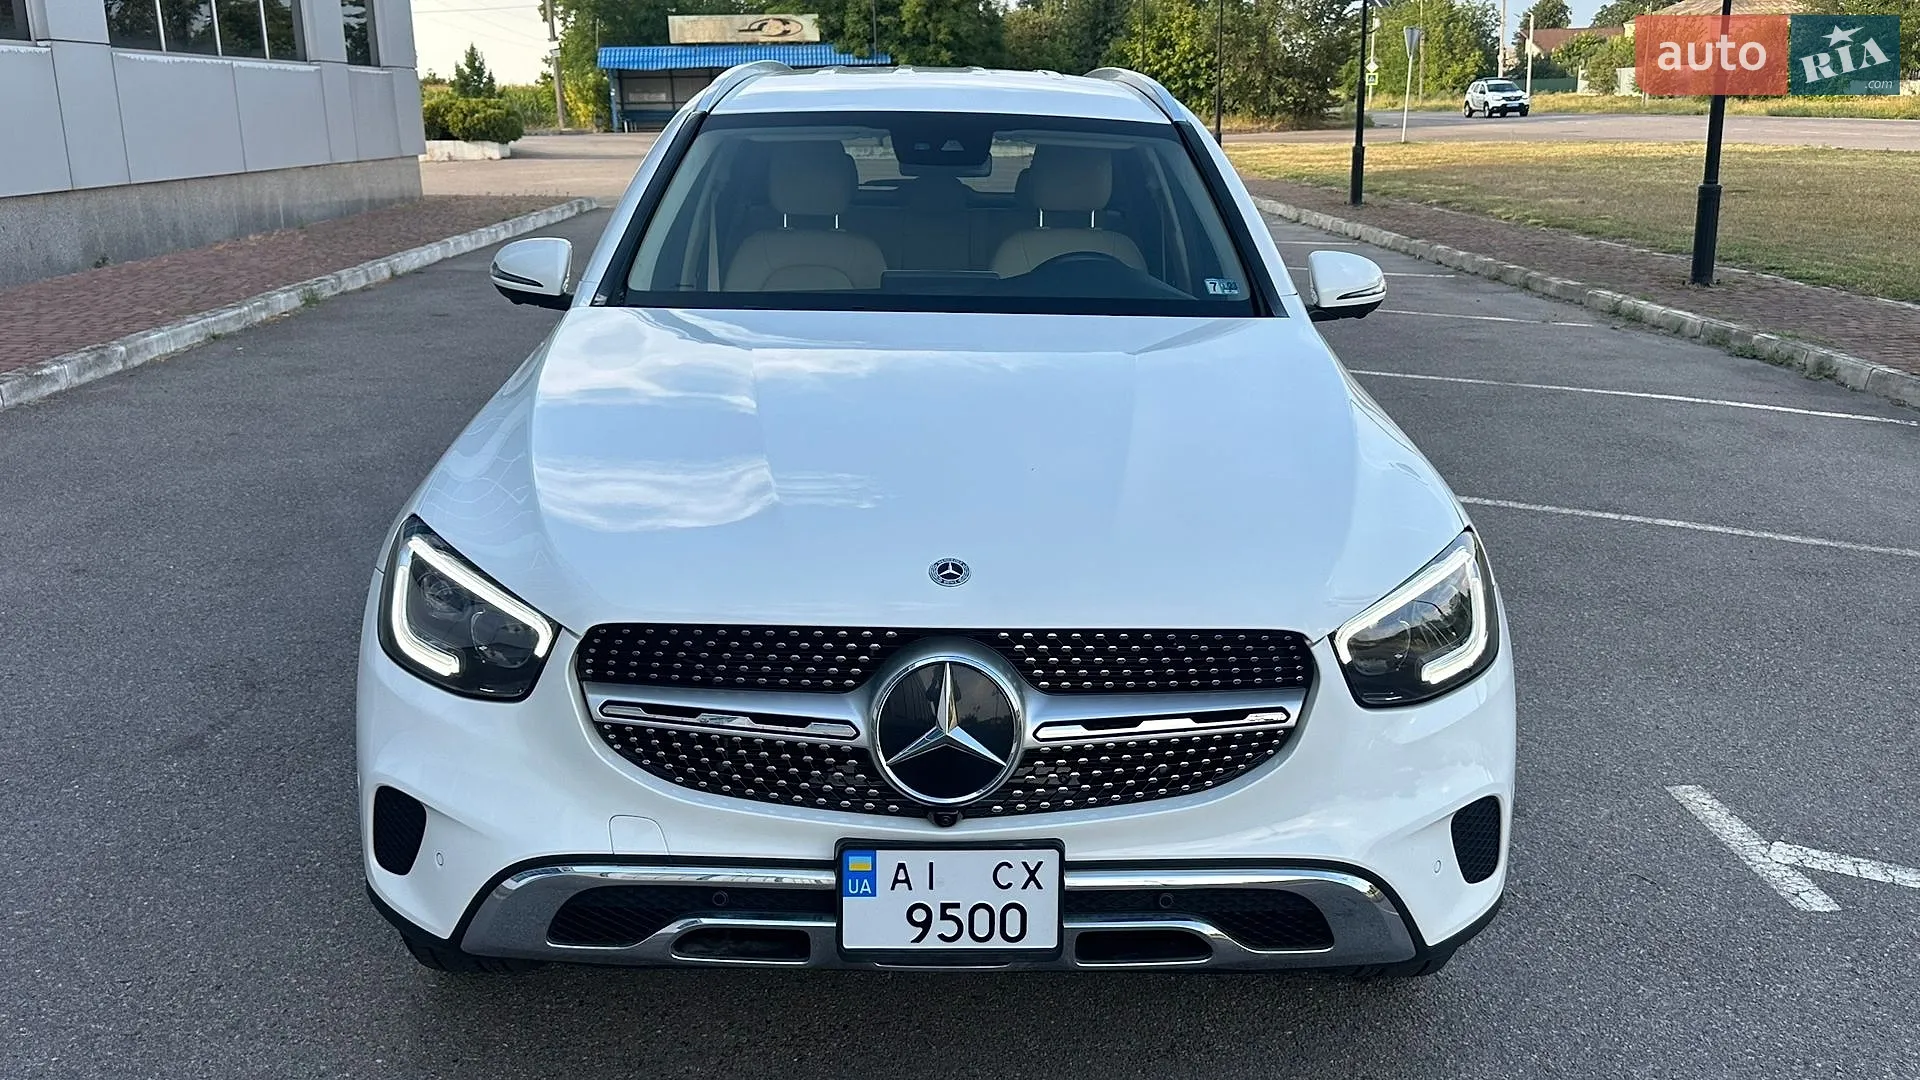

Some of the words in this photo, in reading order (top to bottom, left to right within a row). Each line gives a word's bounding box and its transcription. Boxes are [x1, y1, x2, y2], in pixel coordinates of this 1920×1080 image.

[848, 879, 872, 894] UA
[890, 861, 934, 891] AI
[992, 861, 1044, 890] CX
[905, 902, 1028, 943] 9500
